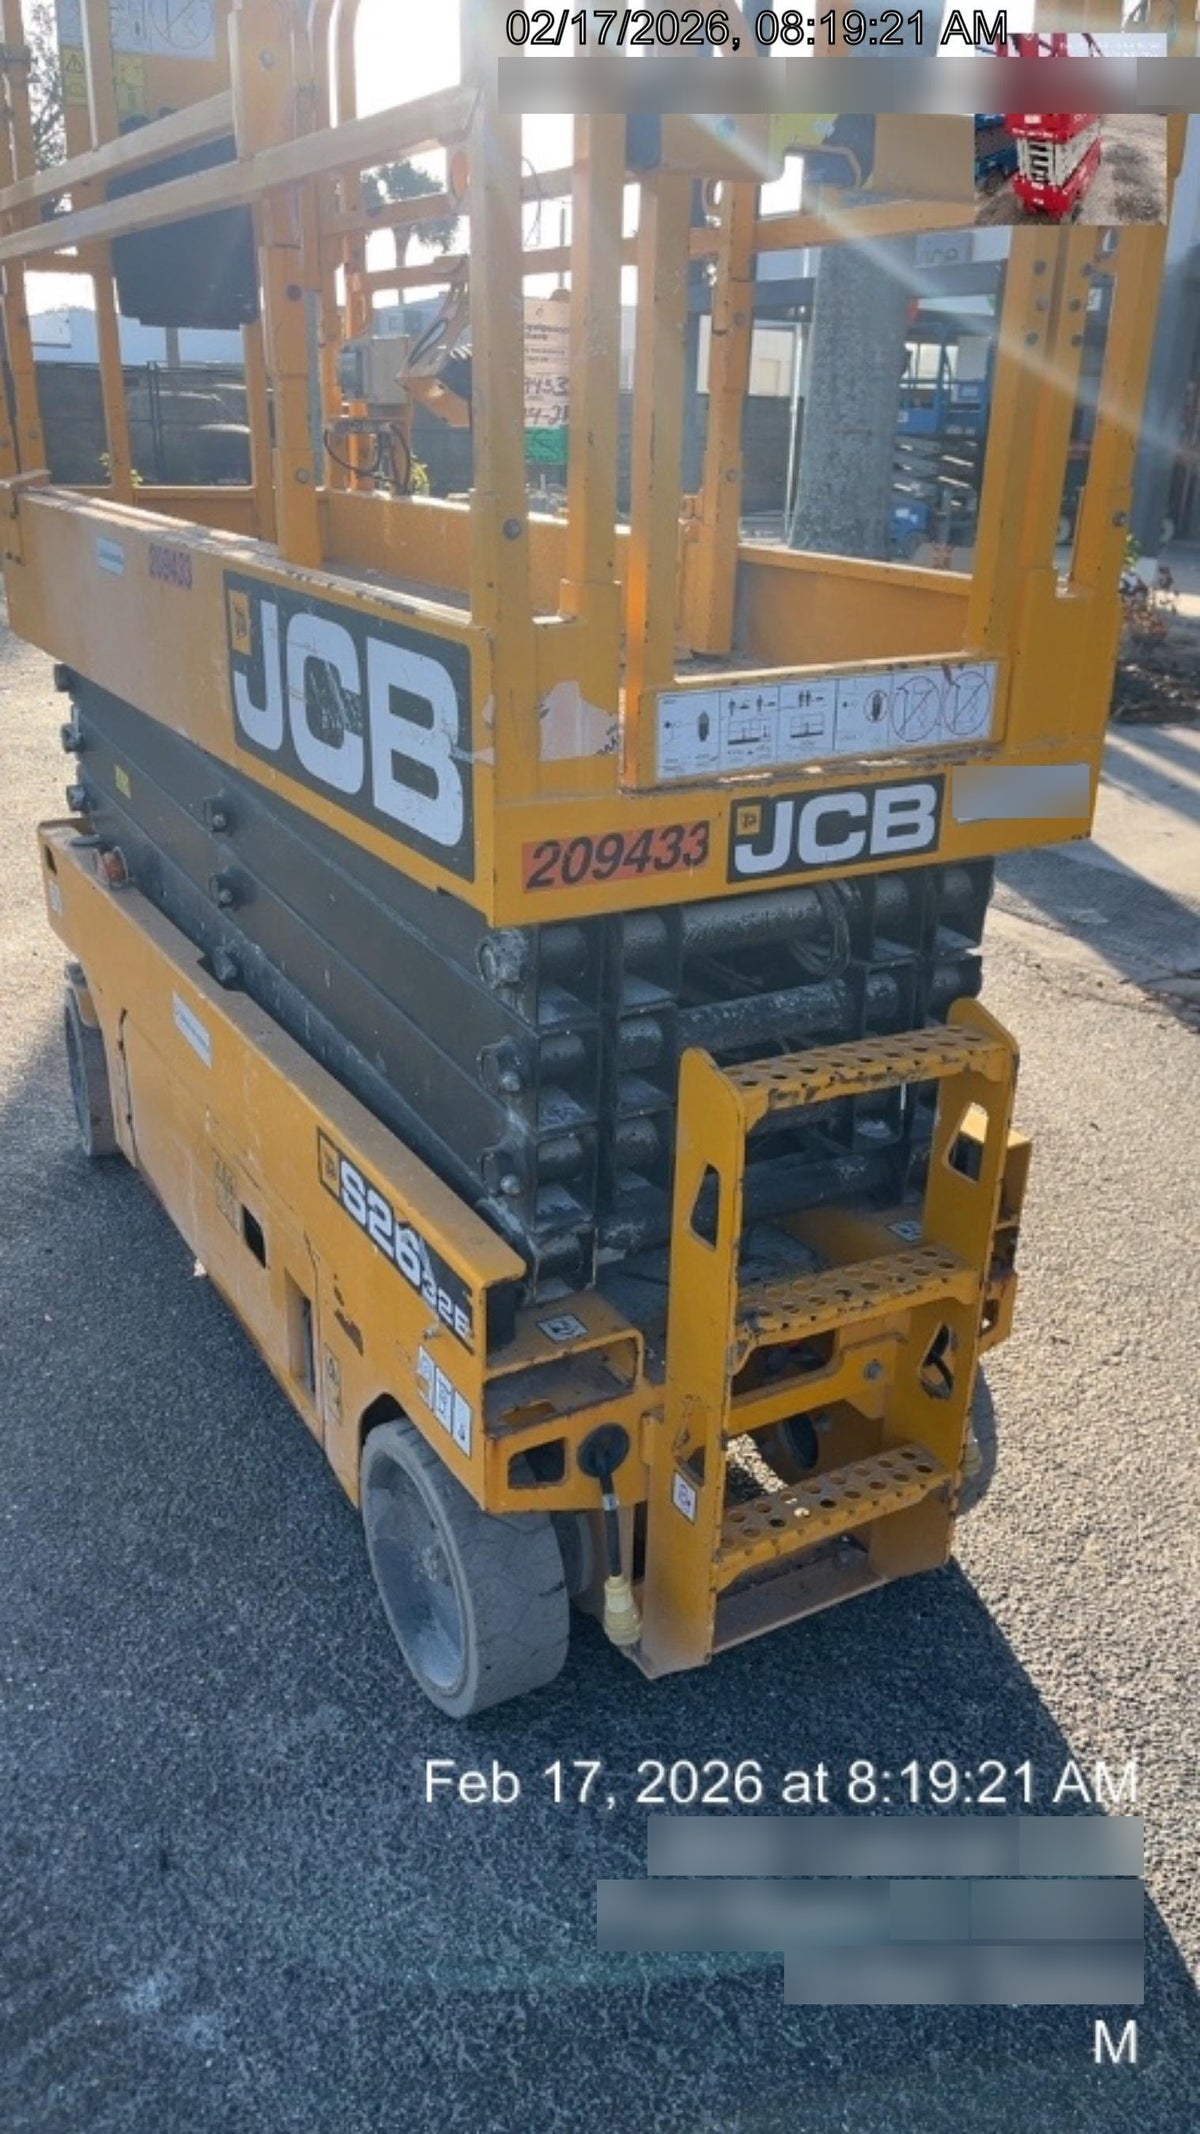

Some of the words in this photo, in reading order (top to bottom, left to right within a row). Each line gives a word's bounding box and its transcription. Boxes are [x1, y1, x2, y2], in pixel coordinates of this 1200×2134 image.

[234, 600, 463, 847] JCB
[526, 820, 710, 890] 209433
[734, 783, 938, 874] JCB
